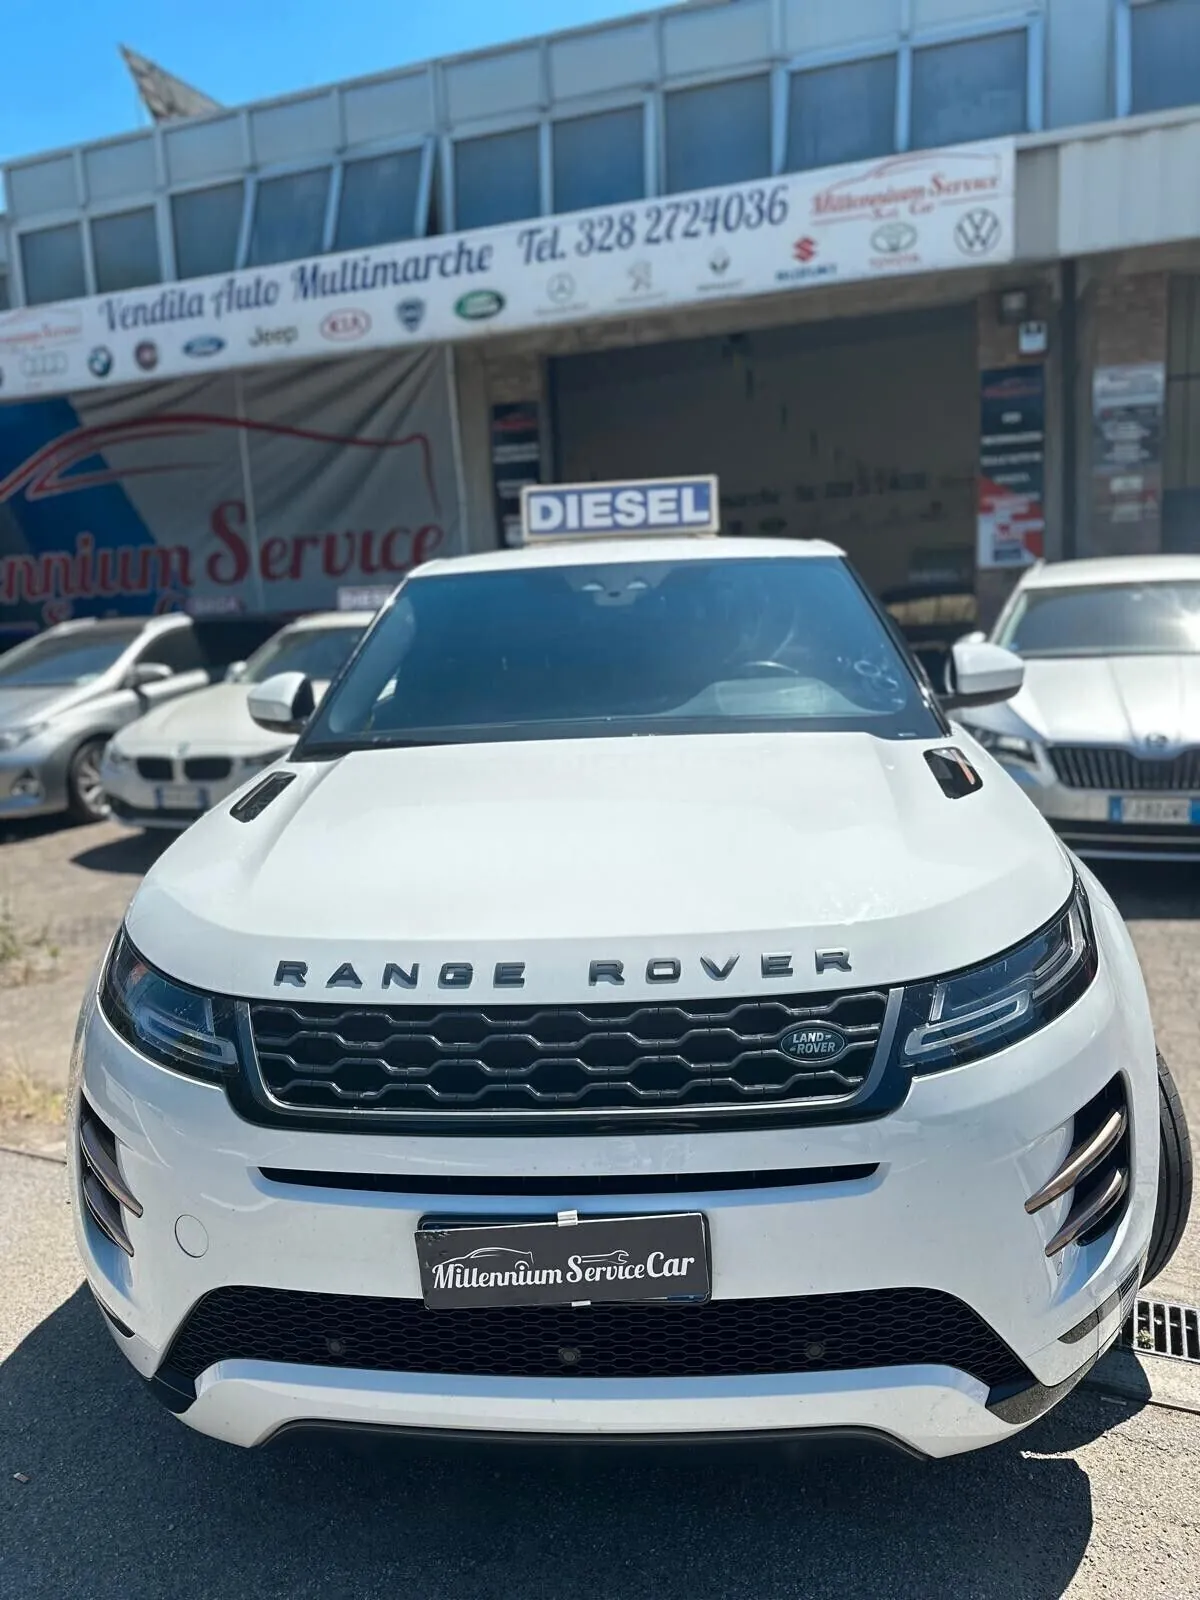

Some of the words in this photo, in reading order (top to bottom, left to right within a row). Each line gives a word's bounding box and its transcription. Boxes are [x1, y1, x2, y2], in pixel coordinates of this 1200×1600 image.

[98, 287, 205, 332] Vendita
[210, 276, 280, 320] Auto
[290, 239, 493, 302] Multimarche
[518, 226, 566, 265] Tel.
[575, 209, 636, 257] 328
[644, 184, 788, 245] 2724036
[529, 487, 710, 531] DIESEL
[0, 532, 196, 602] nnium
[206, 499, 443, 586] Service
[275, 959, 527, 989] RANGE
[588, 948, 853, 986] ROVER
[793, 1032, 824, 1043] LAND
[796, 1042, 836, 1054] ROVER
[432, 1264, 563, 1289] Millennium
[567, 1254, 645, 1283] Service
[645, 1251, 695, 1278] Car
